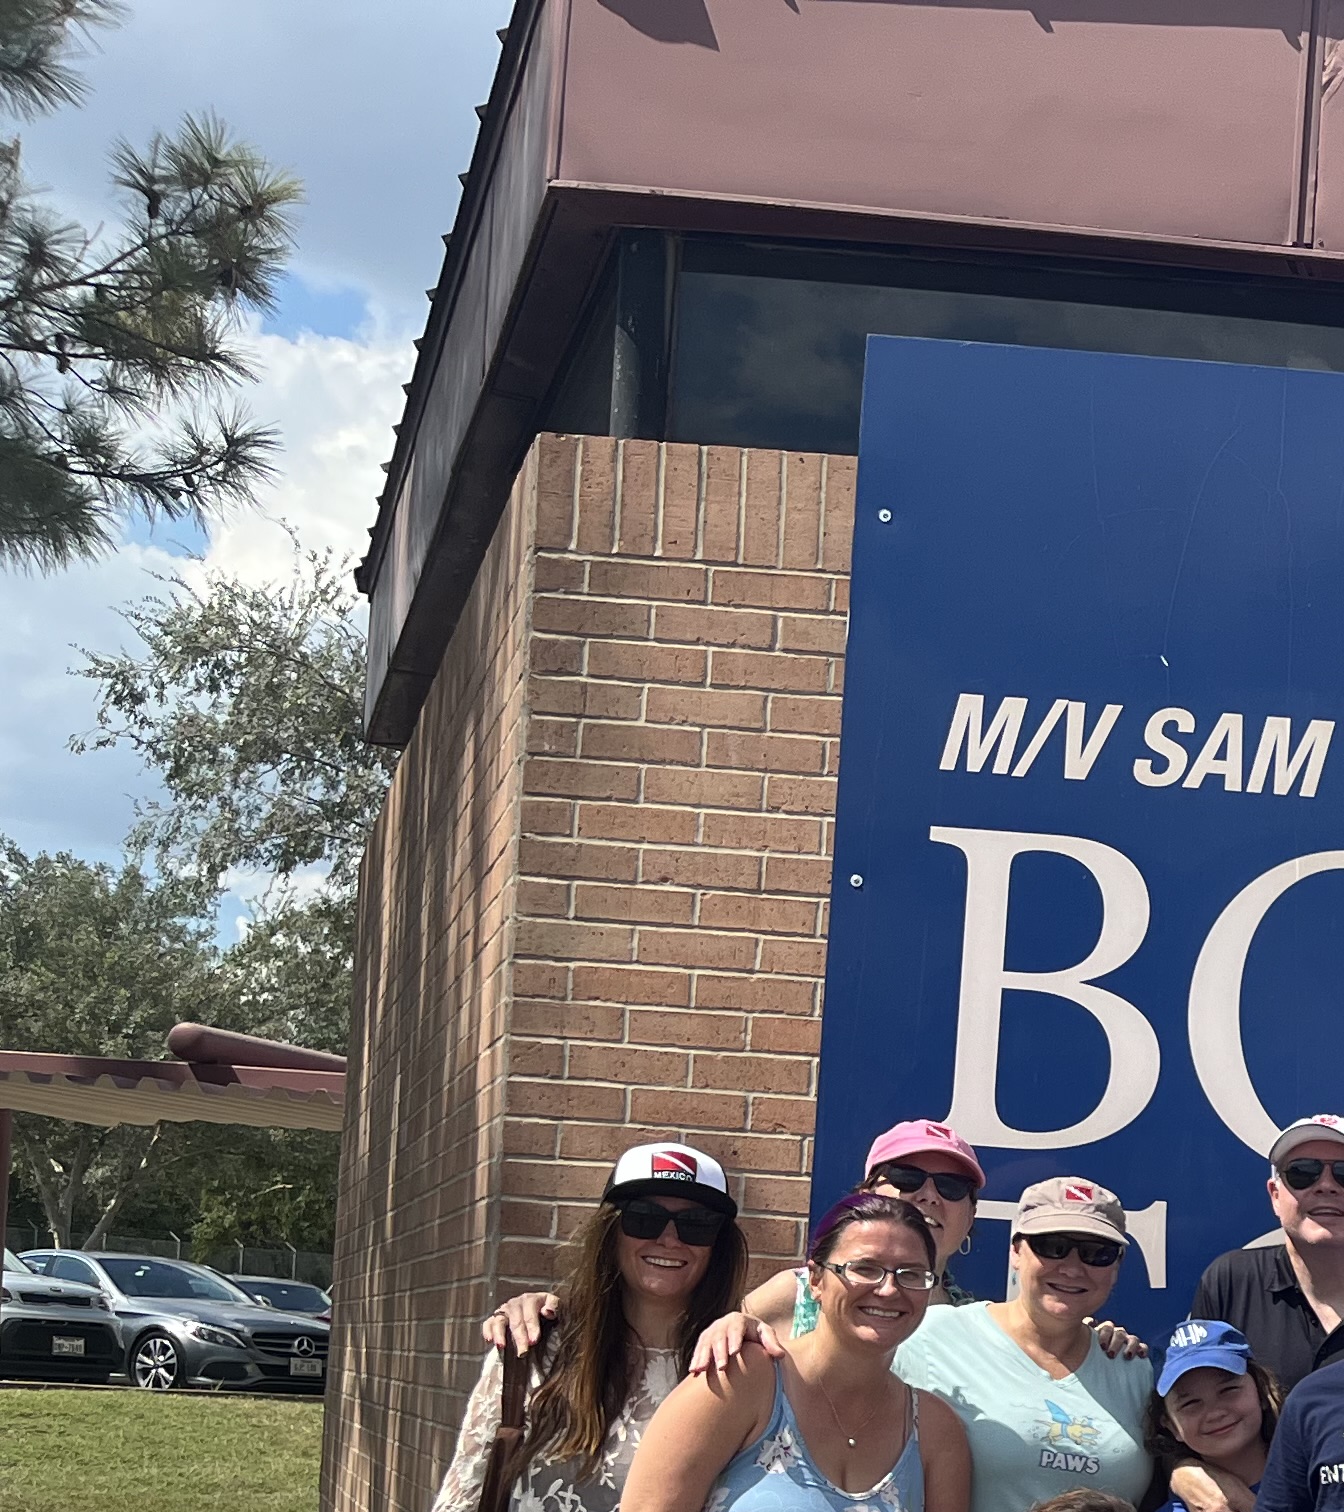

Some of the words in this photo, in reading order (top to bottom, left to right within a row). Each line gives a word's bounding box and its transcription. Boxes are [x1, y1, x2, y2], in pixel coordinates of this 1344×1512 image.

[938, 692, 1124, 781] M/V
[1132, 706, 1338, 799] SAM
[653, 1170, 692, 1180] MEXICO
[1039, 1448, 1100, 1474] PAWS
